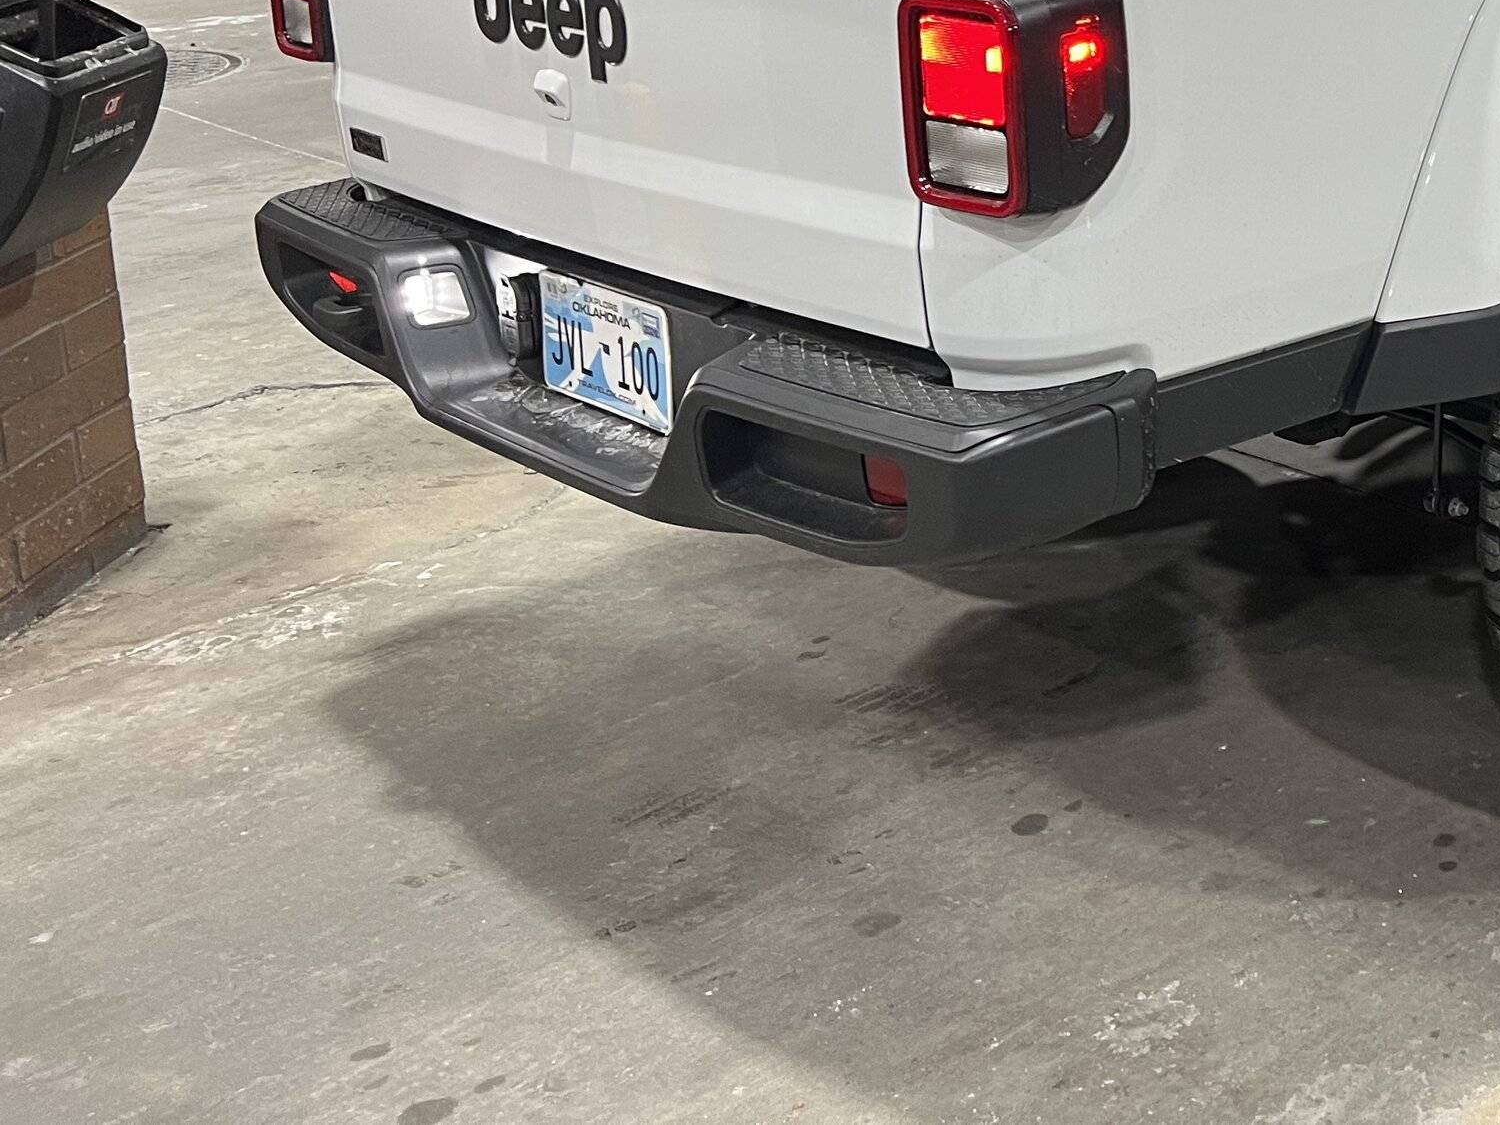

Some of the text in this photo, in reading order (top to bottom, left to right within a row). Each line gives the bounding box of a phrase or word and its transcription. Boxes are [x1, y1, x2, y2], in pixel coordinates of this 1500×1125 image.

[572, 301, 632, 331] OKLAHOMA
[551, 314, 660, 402] JVL 100
